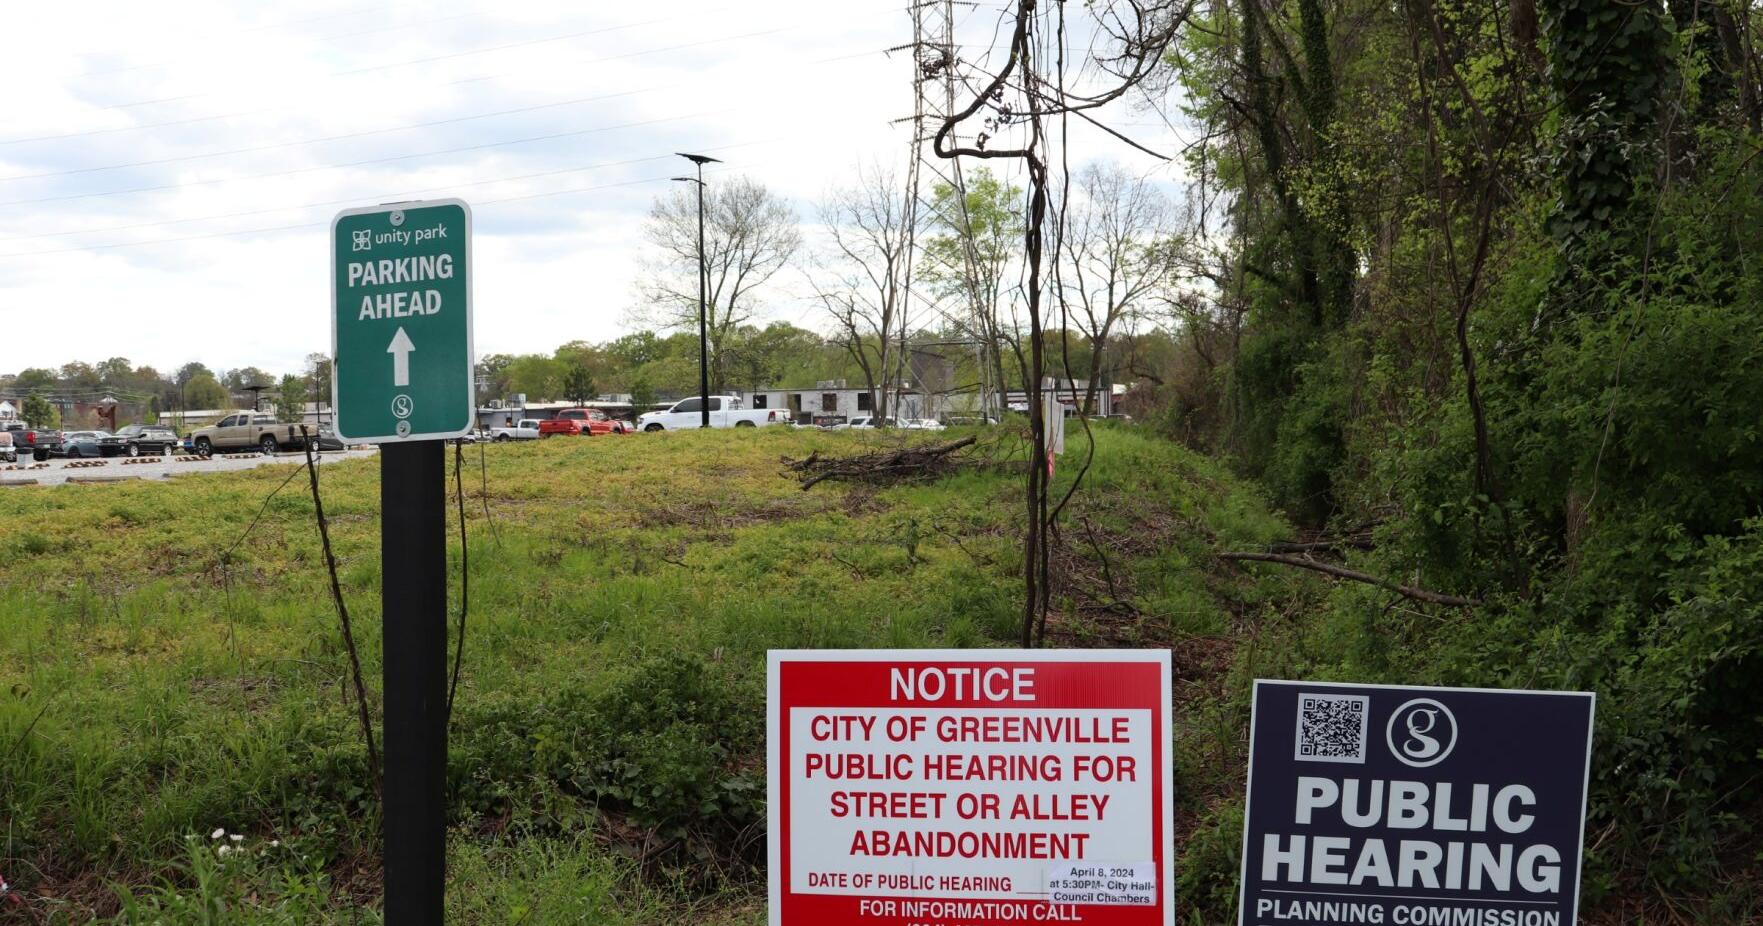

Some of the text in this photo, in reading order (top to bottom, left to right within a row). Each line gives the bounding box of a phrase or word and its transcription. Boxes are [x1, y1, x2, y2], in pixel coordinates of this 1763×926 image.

[375, 223, 447, 246] unity park
[348, 254, 453, 287] PARKING
[358, 290, 442, 321] AHEAD
[890, 667, 1036, 701] NOTICE
[810, 715, 1130, 743] CITY OF GREENVILLE
[805, 753, 1136, 782] PUBLIC HEARING FOR
[830, 792, 1110, 820] STREET OR ALLEY
[1295, 776, 1537, 834] PUBLIC
[849, 831, 1090, 859] ABANDONMENT
[1070, 867, 1134, 878] April 8, 2024
[1261, 833, 1562, 893] HEARING
[808, 872, 1012, 892] DATE OF PUBLIC HEARING
[1049, 880, 1060, 888] at
[1107, 880, 1128, 891] City
[860, 900, 1082, 921] FOR INFORMATION CALL
[1053, 892, 1150, 903] Council Chambers
[1256, 898, 1560, 926] PLANNING COMMISSION
